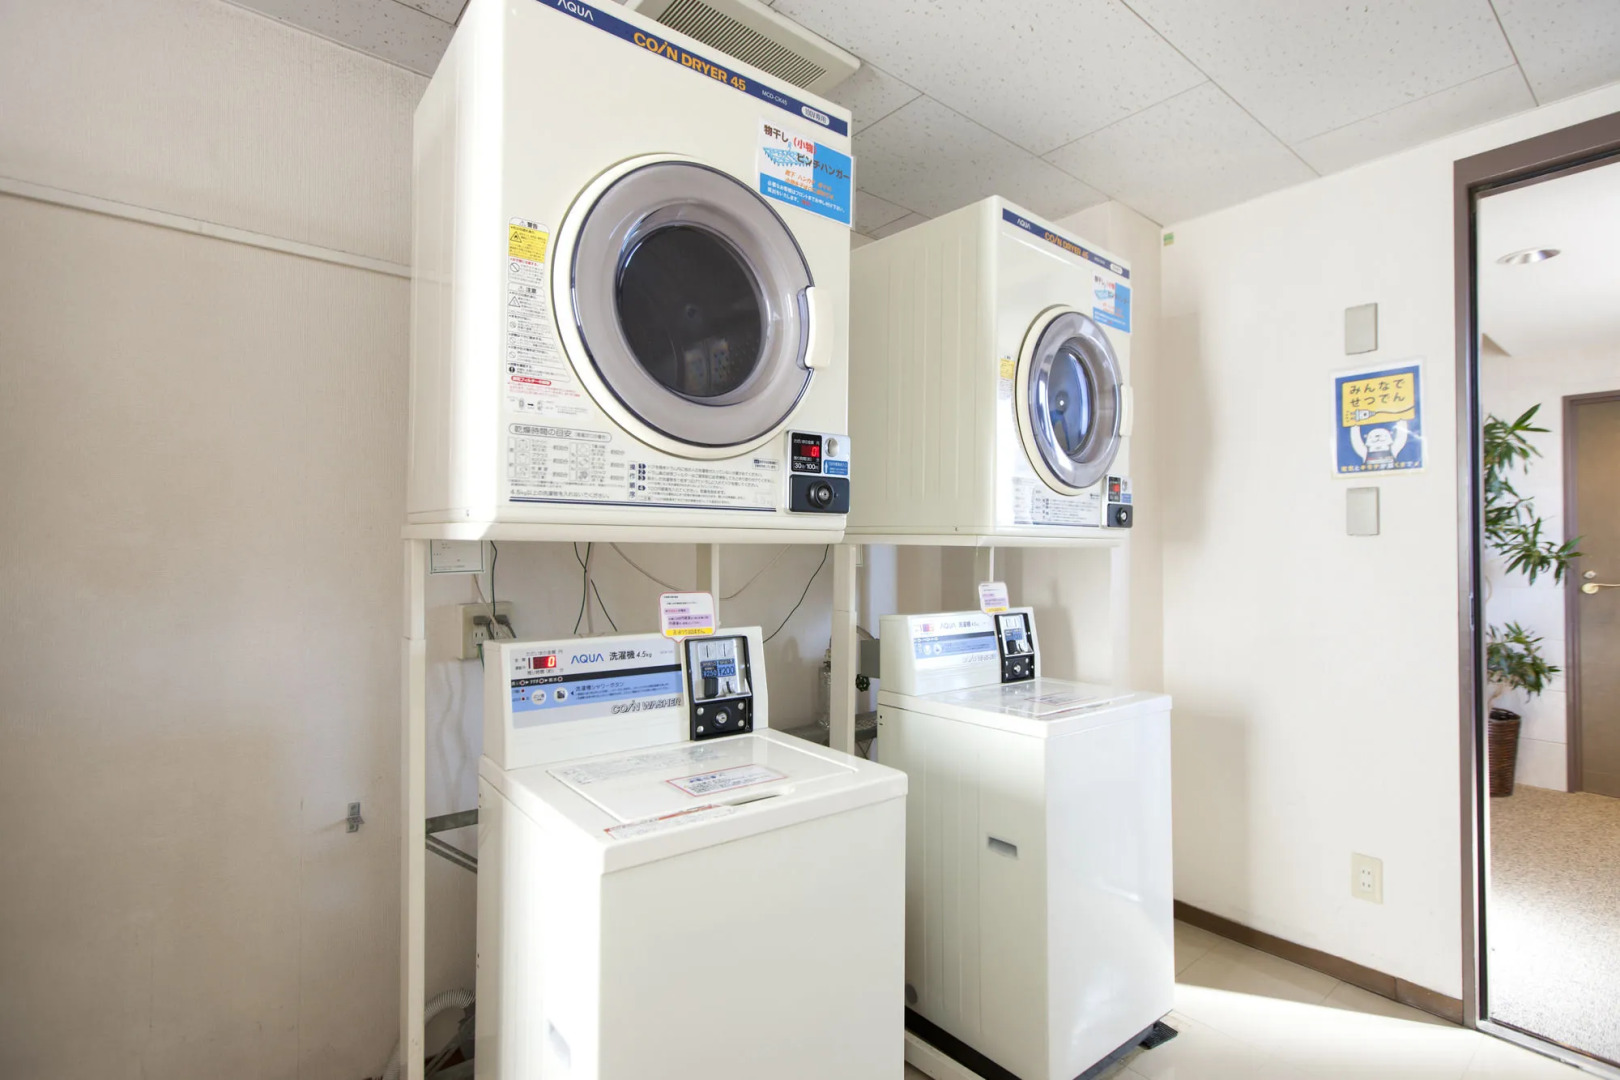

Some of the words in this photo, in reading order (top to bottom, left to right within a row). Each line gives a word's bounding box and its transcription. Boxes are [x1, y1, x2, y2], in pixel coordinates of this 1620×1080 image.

[558, 0, 594, 21] AQUA
[681, 53, 728, 84] DRYER
[730, 76, 747, 91] 45
[763, 124, 789, 143] 物干し
[1349, 378, 1405, 395] みんなで
[547, 656, 555, 667] 0
[571, 653, 604, 665] AQUA
[609, 650, 635, 661] 洗濯機
[642, 697, 682, 710] WASHER
